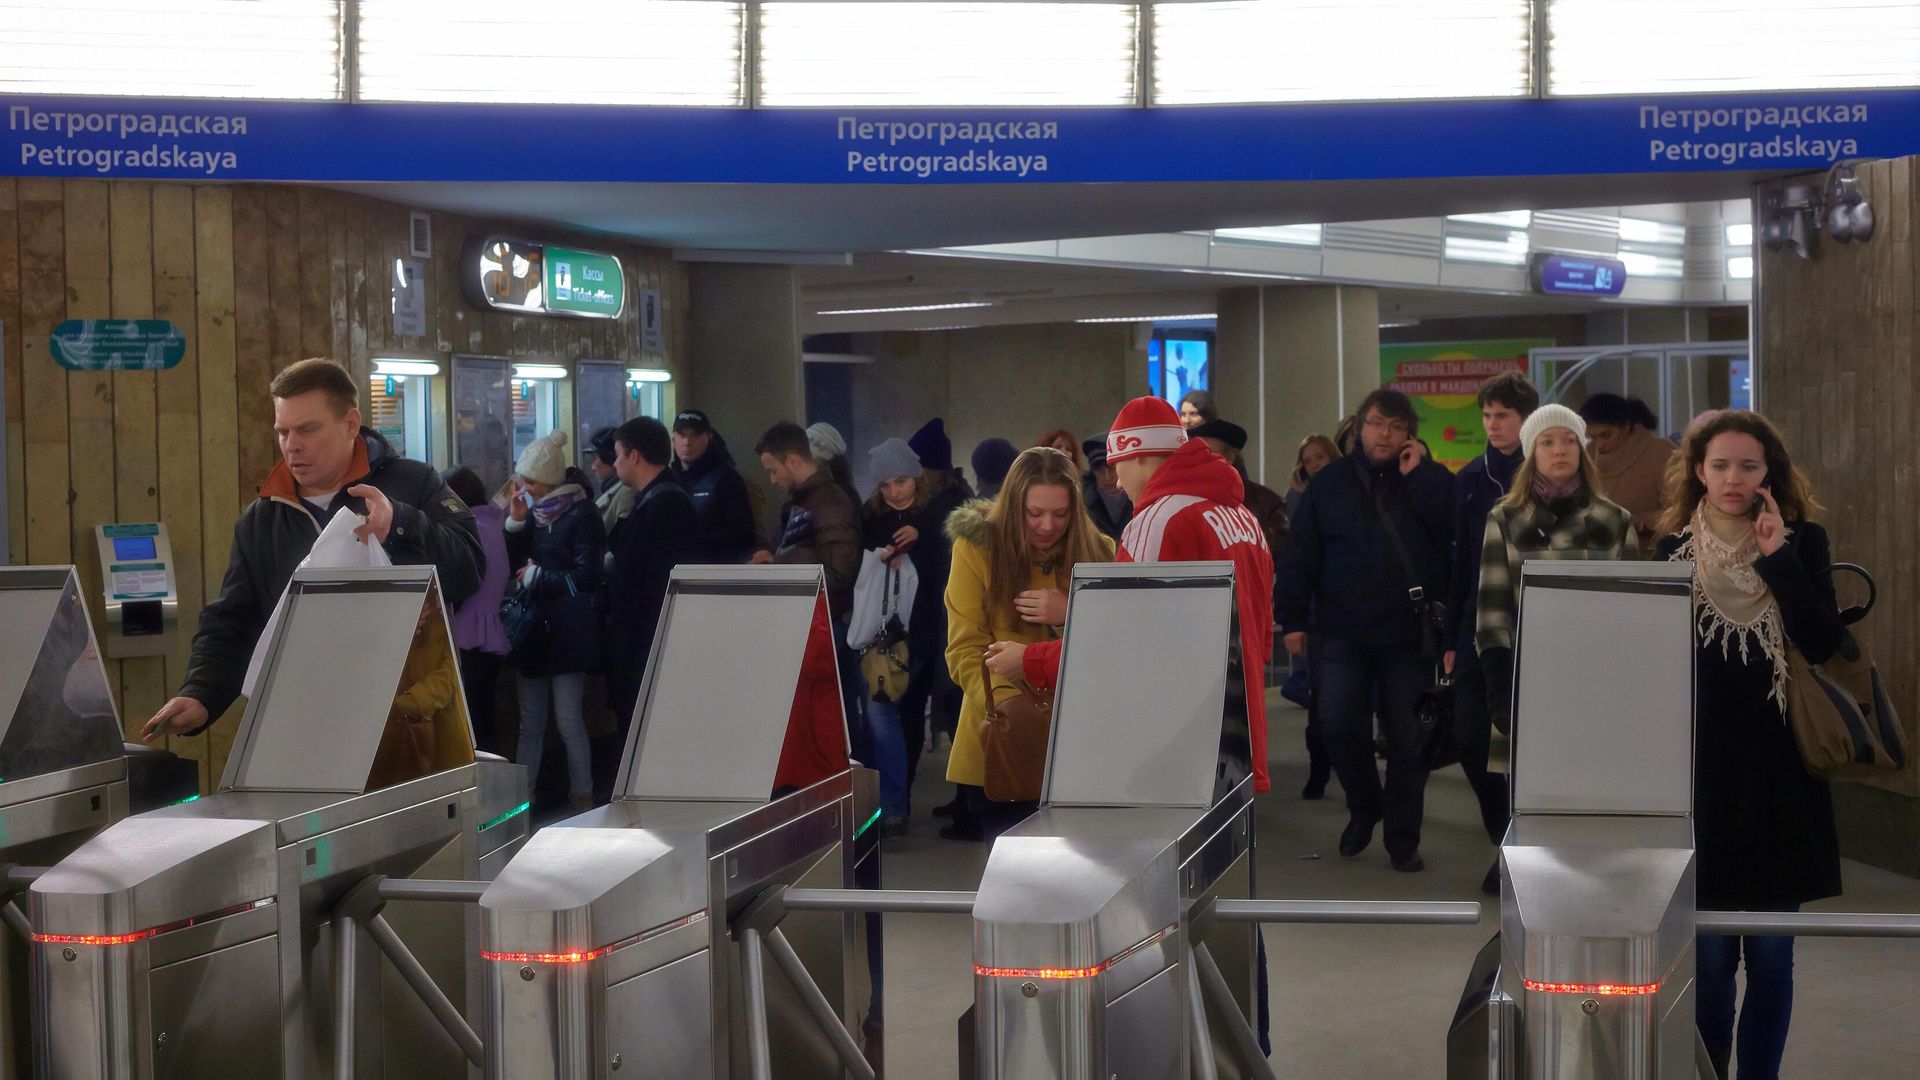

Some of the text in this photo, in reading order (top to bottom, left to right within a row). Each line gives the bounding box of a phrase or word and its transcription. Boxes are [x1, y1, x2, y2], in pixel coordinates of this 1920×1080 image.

[9, 105, 247, 139] Петроградская
[838, 116, 1058, 146] Петроградская
[1639, 103, 1868, 133] Петроградская
[21, 143, 237, 174] Petrogradskaya
[847, 150, 1048, 178] Petrogradskaya
[1650, 135, 1858, 165] Petrogradskaya
[582, 265, 604, 282] Кассы
